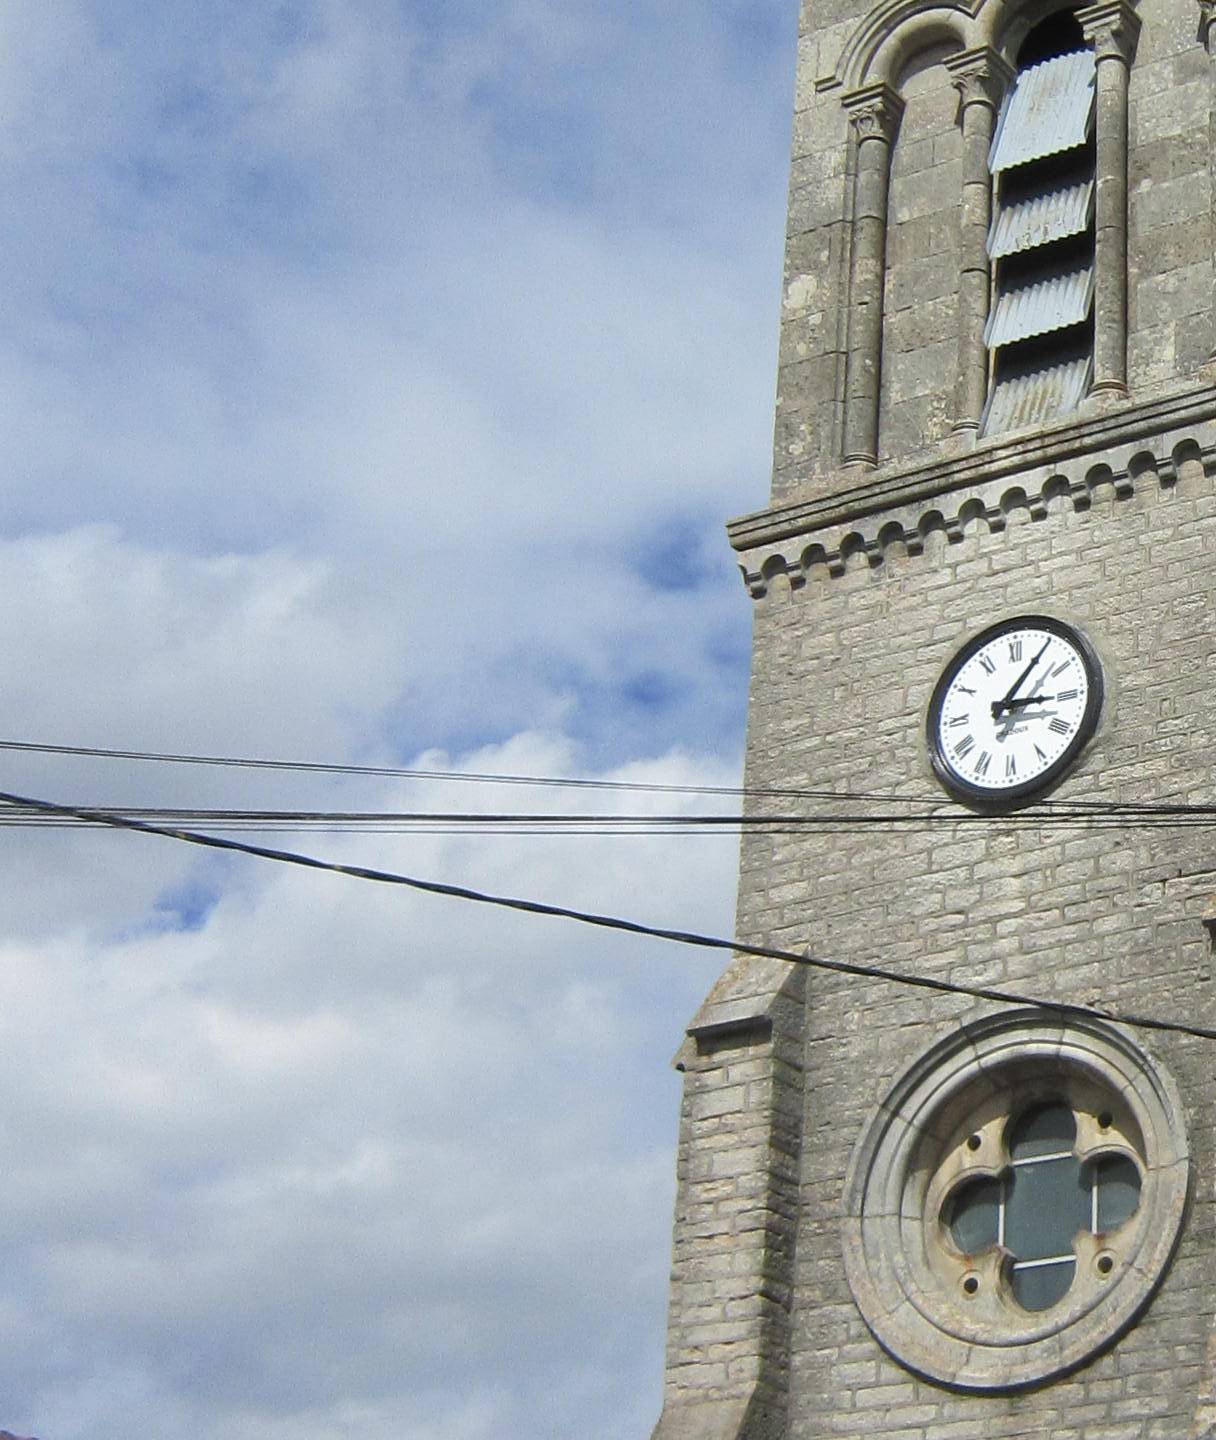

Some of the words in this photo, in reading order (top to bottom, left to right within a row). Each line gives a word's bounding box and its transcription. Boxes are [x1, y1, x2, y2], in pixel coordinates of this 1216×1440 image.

[1008, 640, 1022, 663] XII
[1051, 660, 1071, 678] II
[957, 686, 977, 697] X
[1057, 688, 1078, 702] III
